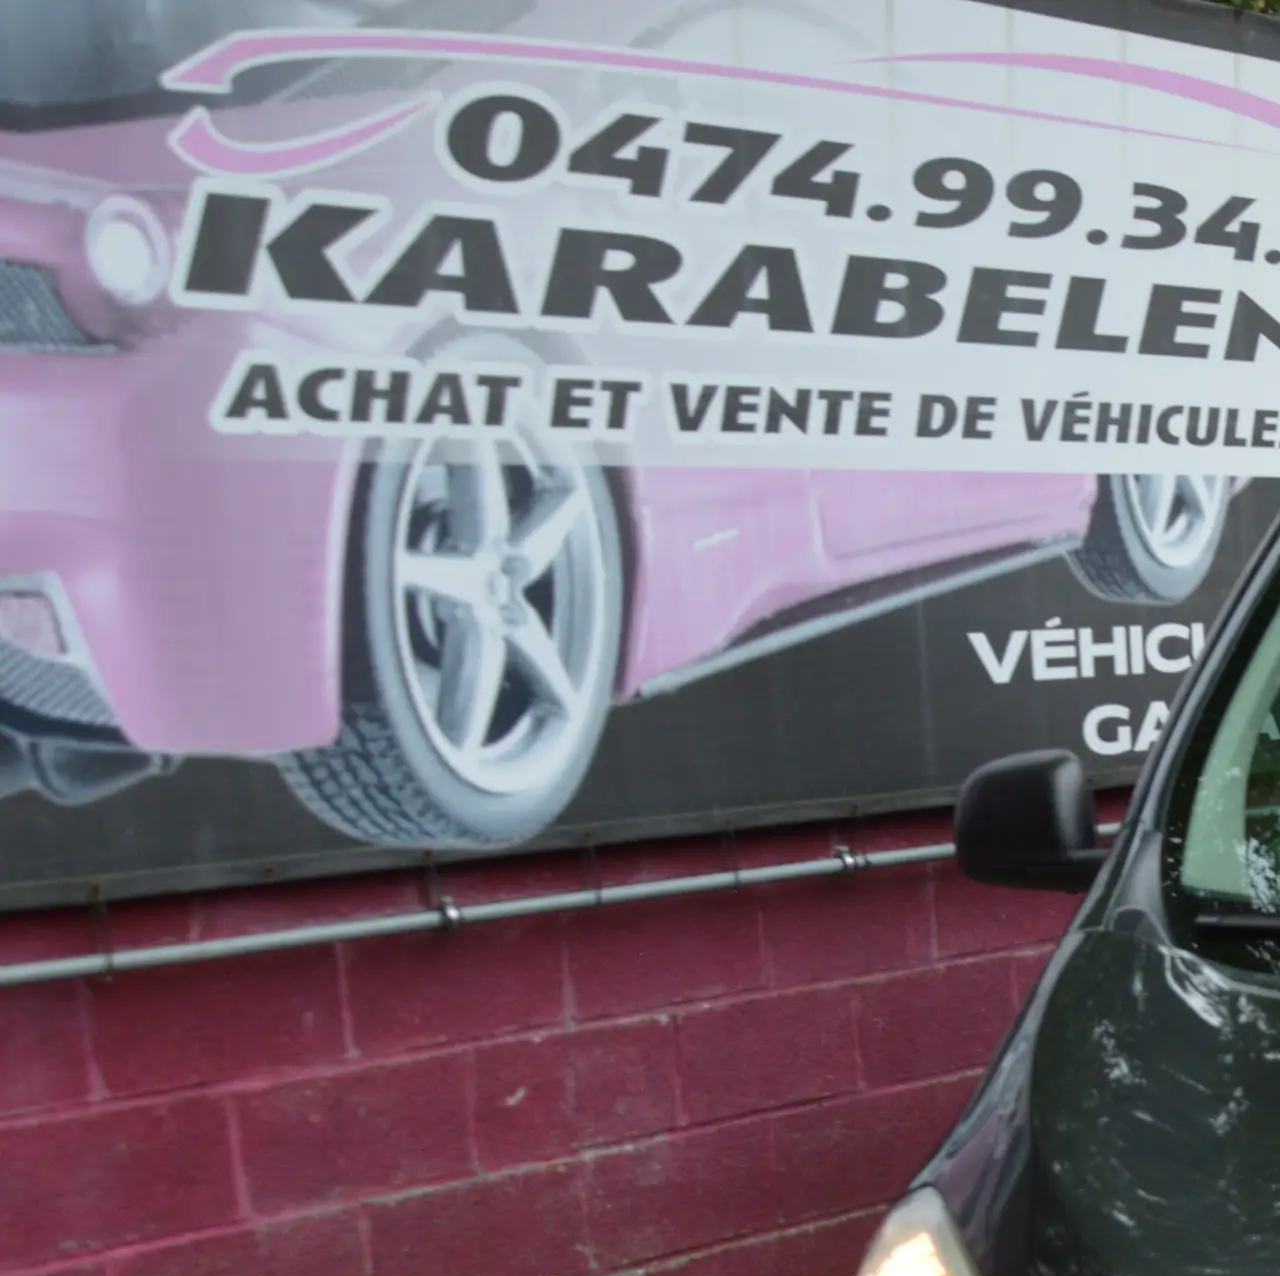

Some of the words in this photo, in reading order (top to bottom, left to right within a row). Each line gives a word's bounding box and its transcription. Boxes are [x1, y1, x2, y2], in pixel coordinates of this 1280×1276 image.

[225, 363, 522, 427] ACHAT
[550, 377, 642, 430] ET
[671, 383, 892, 436] VENTE
[916, 394, 998, 439] DE
